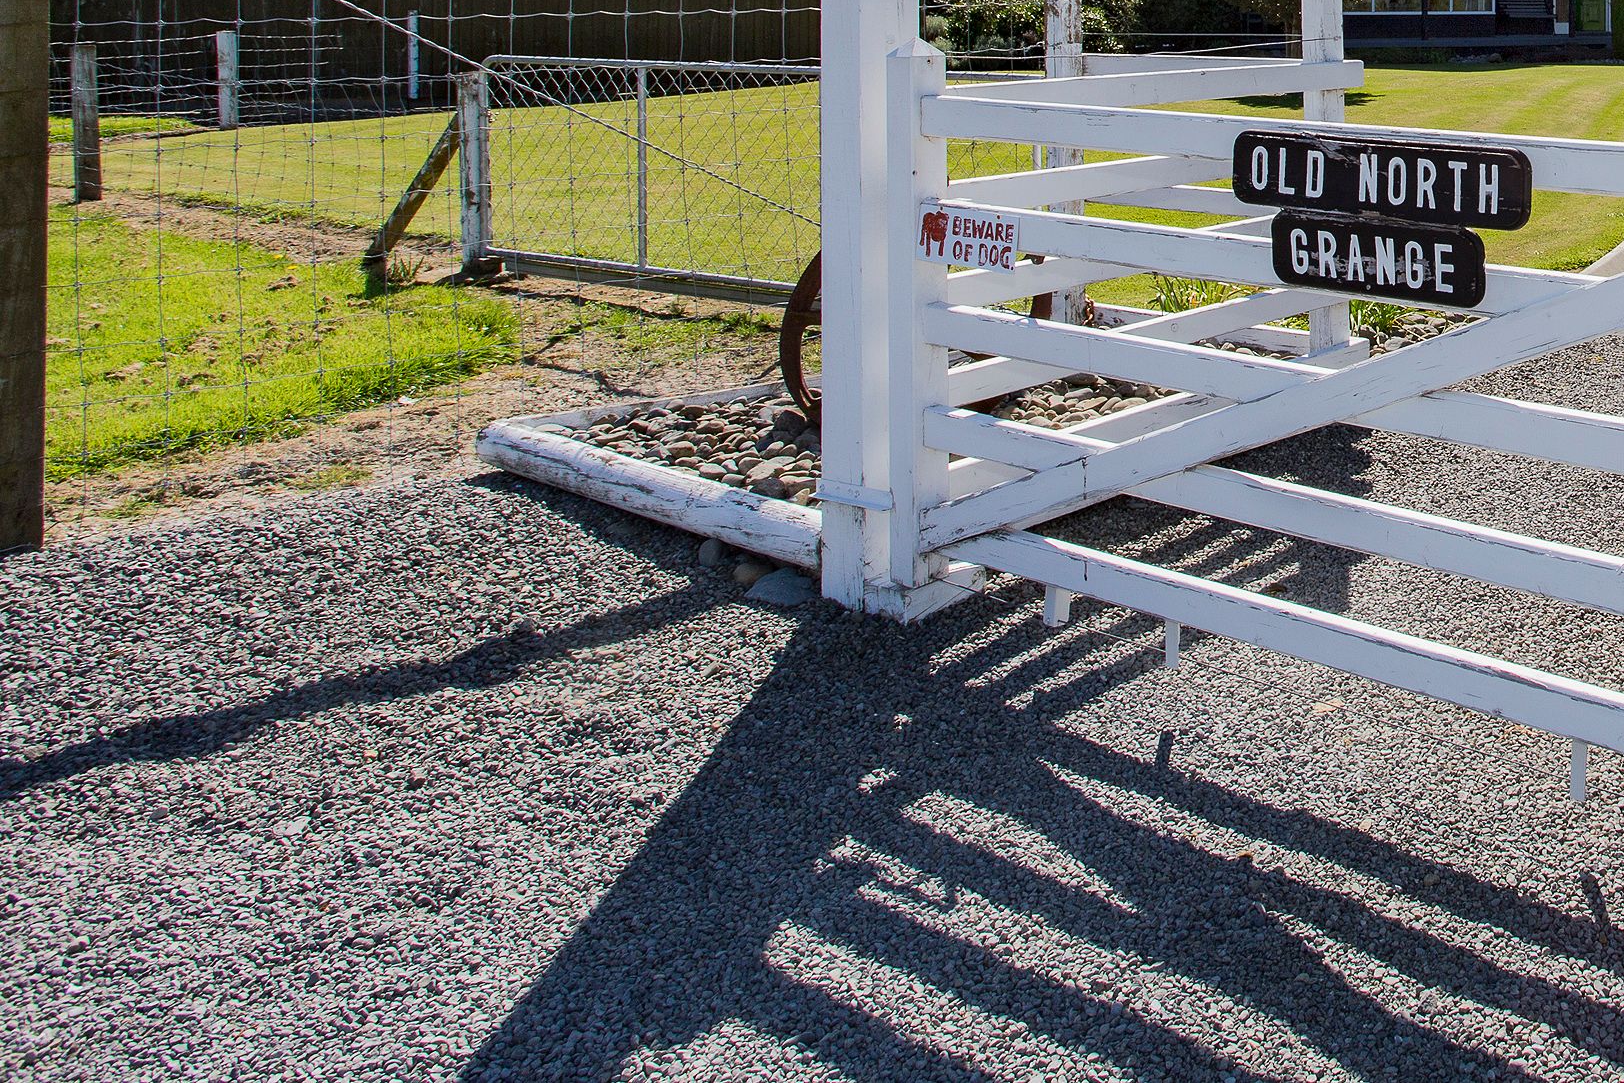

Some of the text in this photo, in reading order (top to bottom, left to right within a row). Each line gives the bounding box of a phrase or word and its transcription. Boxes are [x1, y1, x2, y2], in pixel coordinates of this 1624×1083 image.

[1251, 145, 1499, 215] OLD NORTH
[952, 216, 1014, 243] BEWARE
[953, 240, 974, 262] OF
[1290, 228, 1454, 294] GRANGE
